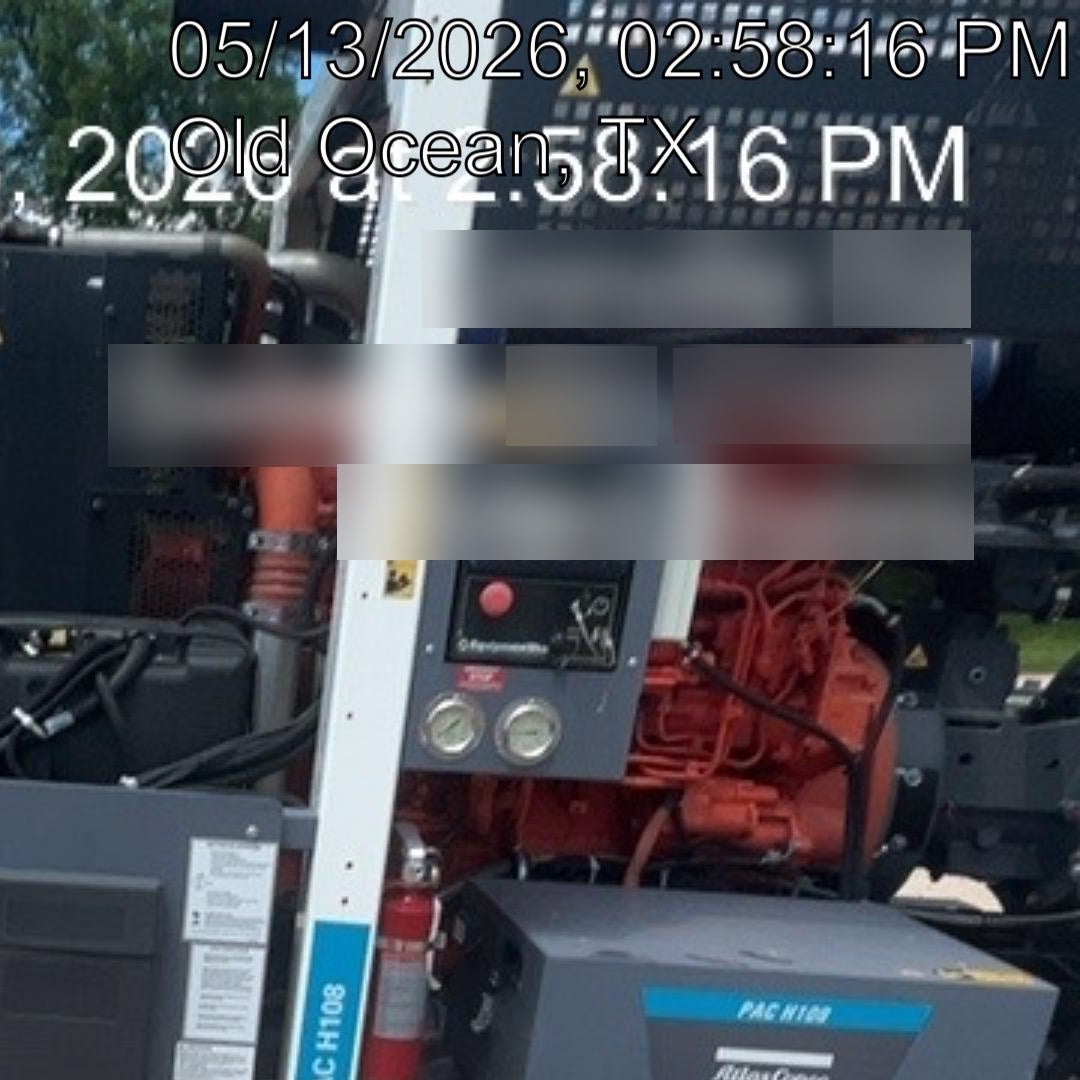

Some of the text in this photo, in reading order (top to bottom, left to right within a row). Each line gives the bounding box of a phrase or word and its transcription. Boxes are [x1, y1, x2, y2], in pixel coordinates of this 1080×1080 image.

[315, 982, 346, 1051] H108
[736, 999, 833, 1025] PAC H108
